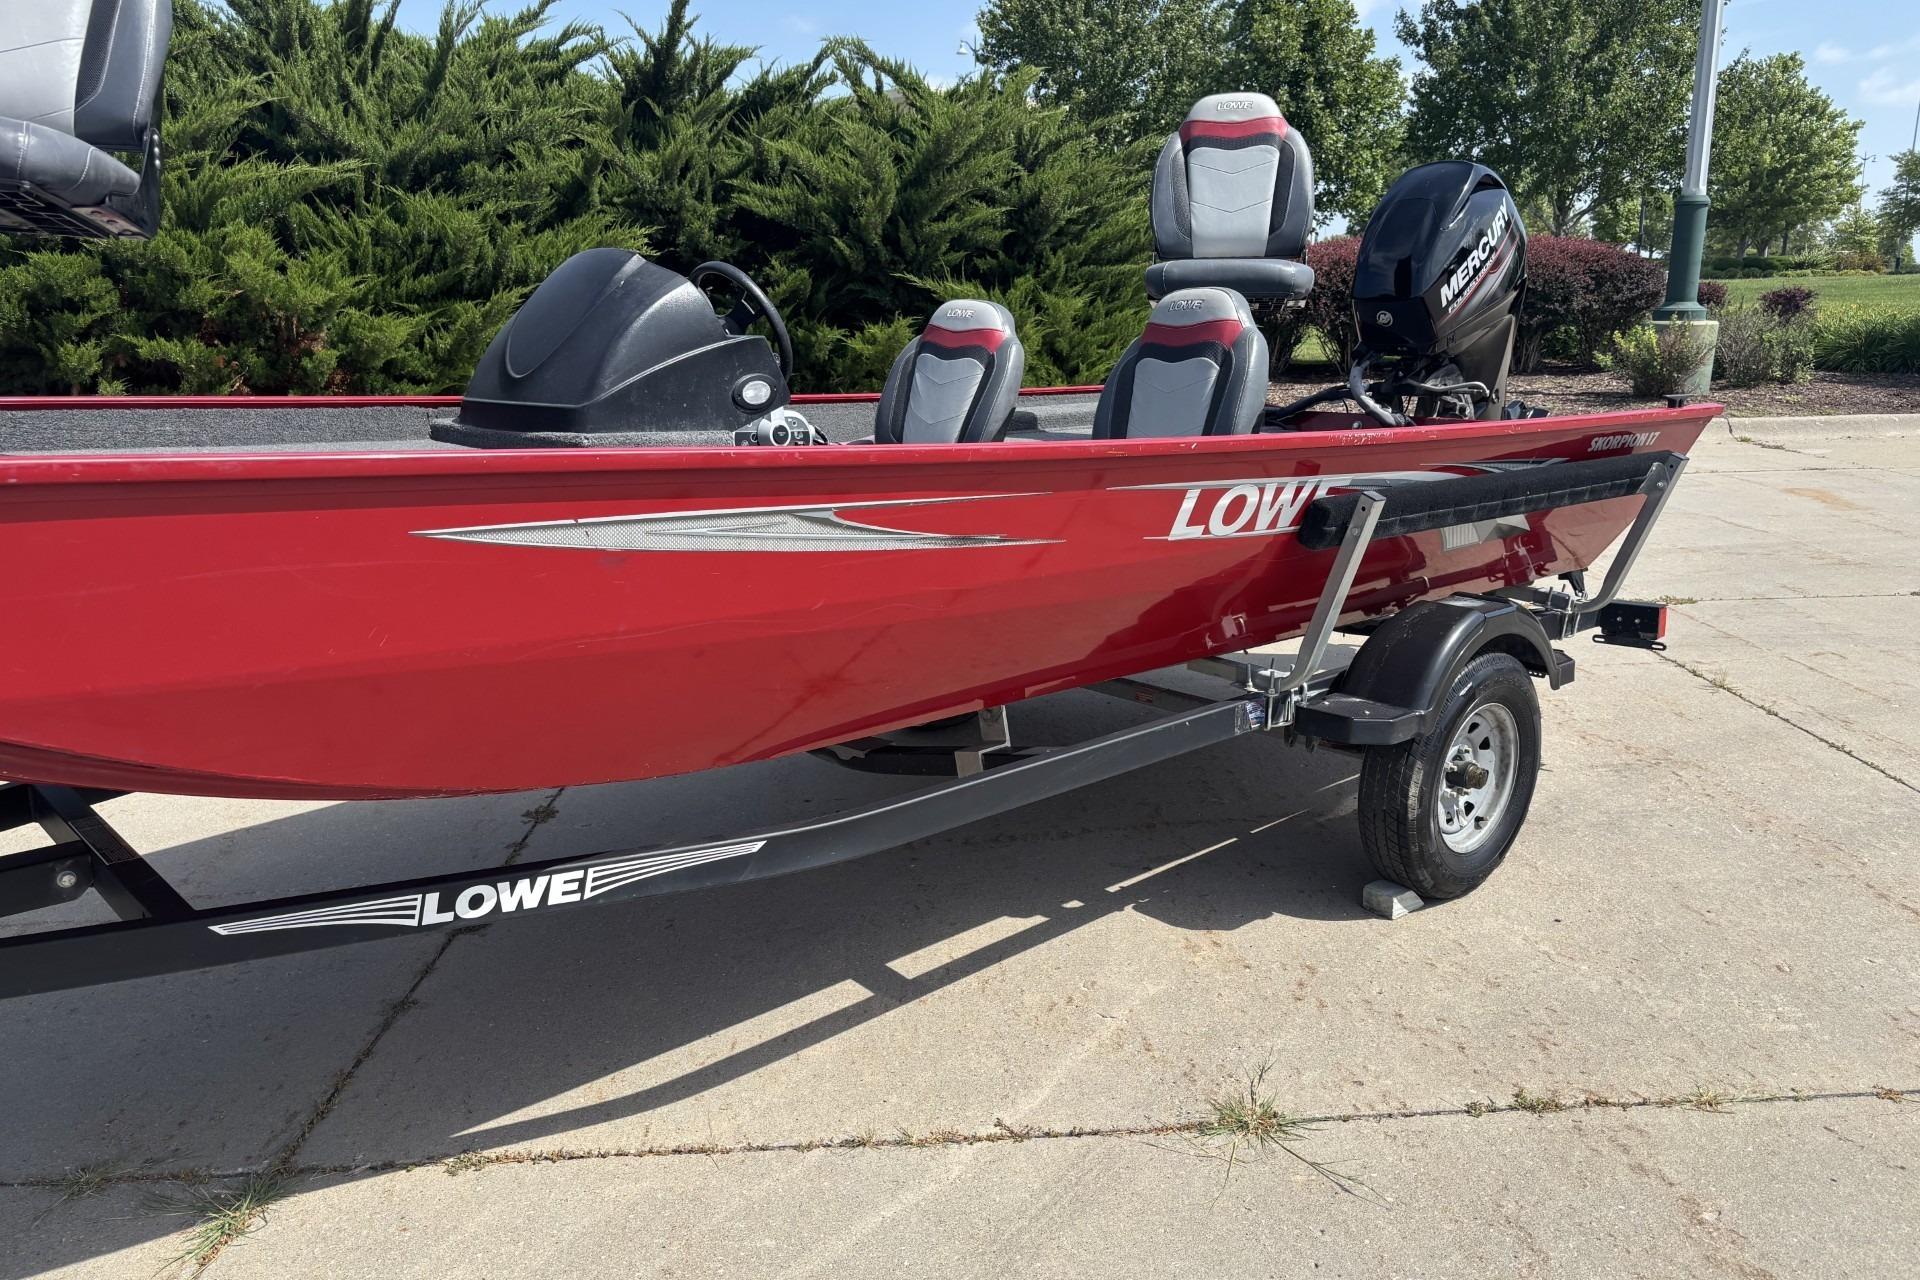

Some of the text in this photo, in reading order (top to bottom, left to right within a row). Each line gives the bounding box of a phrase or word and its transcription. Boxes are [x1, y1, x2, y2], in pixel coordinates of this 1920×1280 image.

[1216, 100, 1254, 111] LOWE
[1440, 196, 1509, 308] MERCURY
[946, 308, 976, 319] LOWE
[1168, 299, 1204, 312] LOWE
[1587, 431, 1660, 452] SKORPION 17
[421, 869, 585, 926] LOWE
